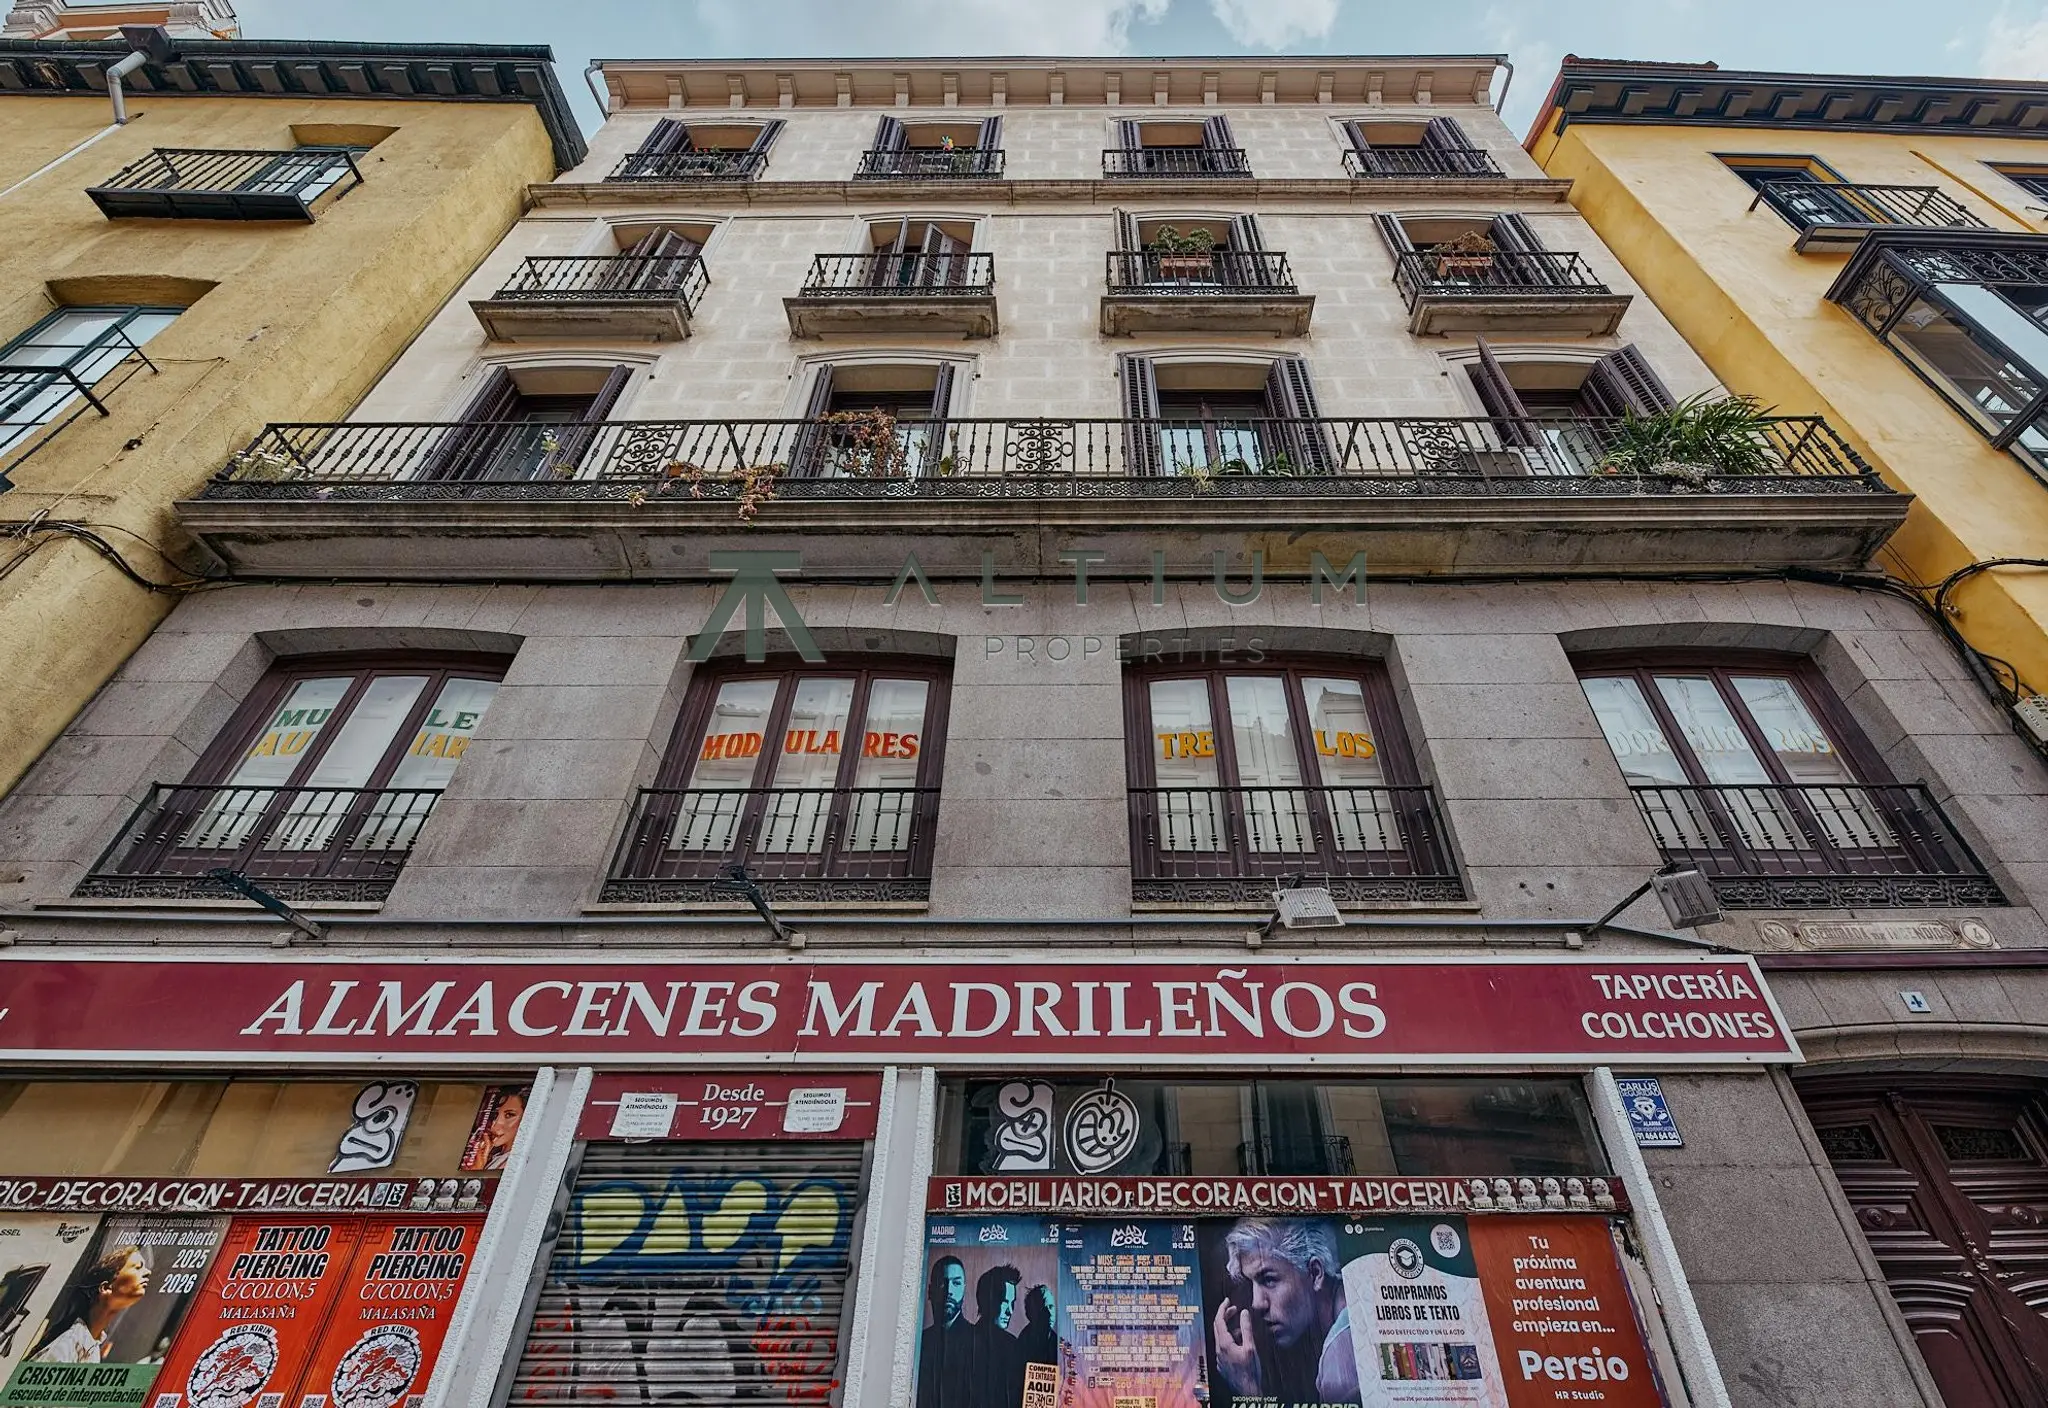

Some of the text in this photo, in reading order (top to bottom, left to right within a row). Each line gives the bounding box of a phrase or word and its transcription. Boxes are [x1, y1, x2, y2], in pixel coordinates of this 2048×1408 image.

[1591, 969, 1757, 1000] TAPICERÍA
[240, 968, 1387, 1039] ALMACENES MADRILEÑOS
[1581, 1012, 1775, 1039] COLCHONES
[702, 1083, 765, 1102] Desde
[700, 1106, 758, 1132] 1927
[966, 1181, 1123, 1207] MOBILIARIO
[115, 1228, 219, 1247] Inscripción abierta
[253, 1225, 331, 1252] TATTOO
[389, 1226, 466, 1252] TATTOO
[932, 1226, 955, 1235] MADRID
[1528, 1236, 1549, 1249] Tu
[172, 1249, 210, 1269] 2025
[227, 1252, 331, 1280] PIERCING
[365, 1252, 466, 1280] PIERCING
[1513, 1253, 1578, 1273] próxima
[159, 1273, 198, 1293] 2026
[1380, 1285, 1448, 1300] COMPRAMOS
[1515, 1277, 1586, 1291] aventura
[219, 1304, 297, 1319] MALASAÑA
[359, 1305, 436, 1320] MALASAÑA
[1376, 1305, 1460, 1321] LIBROS DE TEXTO
[1513, 1295, 1600, 1315] profesional
[229, 1324, 272, 1335] RED KIRIN
[370, 1324, 414, 1336] RED KIRIN
[1513, 1317, 1581, 1337] empieza
[1028, 1364, 1057, 1373] COMPRA
[1517, 1346, 1629, 1381] Persio
[17, 1366, 130, 1387] CRISTINA ROTA
[1035, 1371, 1056, 1382] ENTRADA
[8, 1387, 145, 1405] escuela de interpretación
[1027, 1381, 1055, 1394] AQUI
[1555, 1390, 1605, 1400] HR Studio
